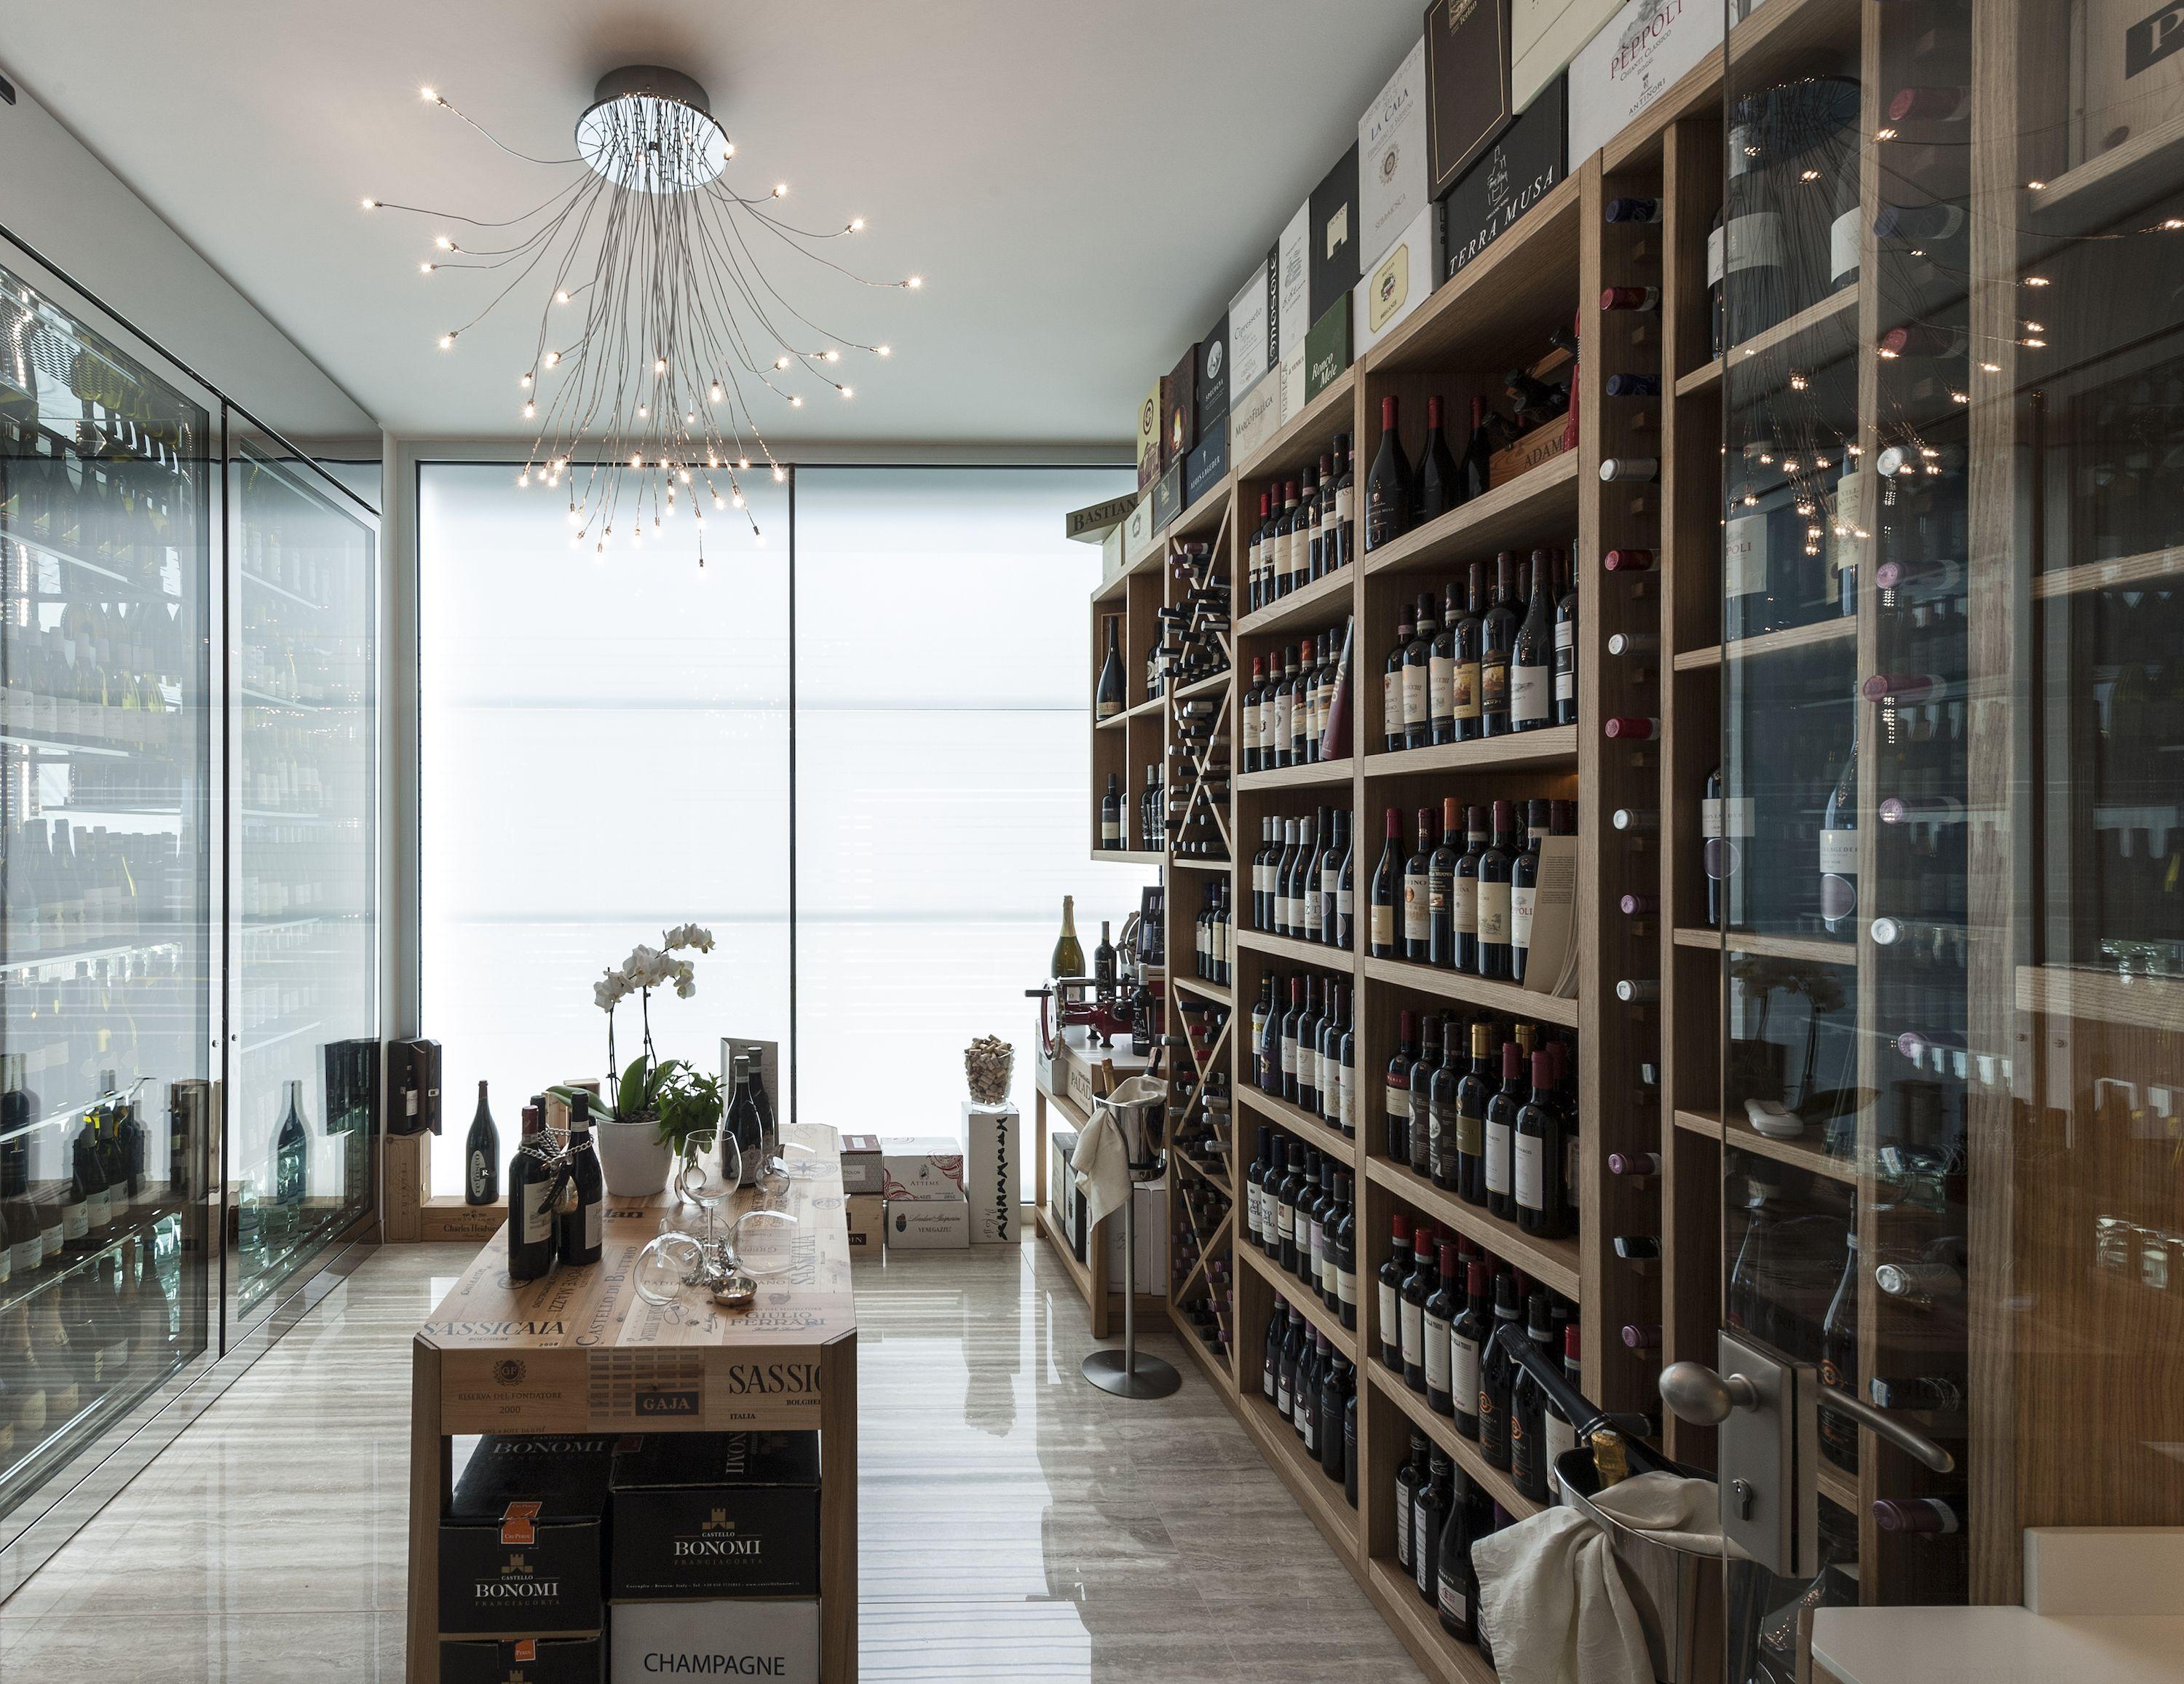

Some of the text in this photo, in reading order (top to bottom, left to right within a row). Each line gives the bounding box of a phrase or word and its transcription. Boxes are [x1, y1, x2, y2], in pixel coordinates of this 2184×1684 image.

[1610, 0, 1682, 81] PÈPPOLI
[1629, 77, 1666, 116] ANTINORI
[1370, 88, 1409, 141] LA CALA
[1449, 165, 1553, 276] TERRA MUSA
[1311, 352, 1334, 382] Ronco
[1319, 363, 1337, 388] Mele
[603, 1209, 646, 1219] lan
[443, 1224, 471, 1233] Charles
[576, 1296, 616, 1346] CASTELLO
[730, 1319, 828, 1327] FERRARI
[745, 1311, 812, 1319] GIULIO
[420, 1321, 565, 1336] SASSICAIA
[458, 1391, 563, 1401] RISERVA DEL FONDATORE
[643, 1397, 691, 1410] GAJA
[499, 1405, 521, 1415] 2000
[492, 1441, 606, 1454] BONOMI
[725, 1431, 748, 1475] NOMI
[674, 1540, 763, 1557] BONOMI
[475, 1582, 560, 1598] BONOMI
[644, 1652, 786, 1676] CHAMPAGNE
